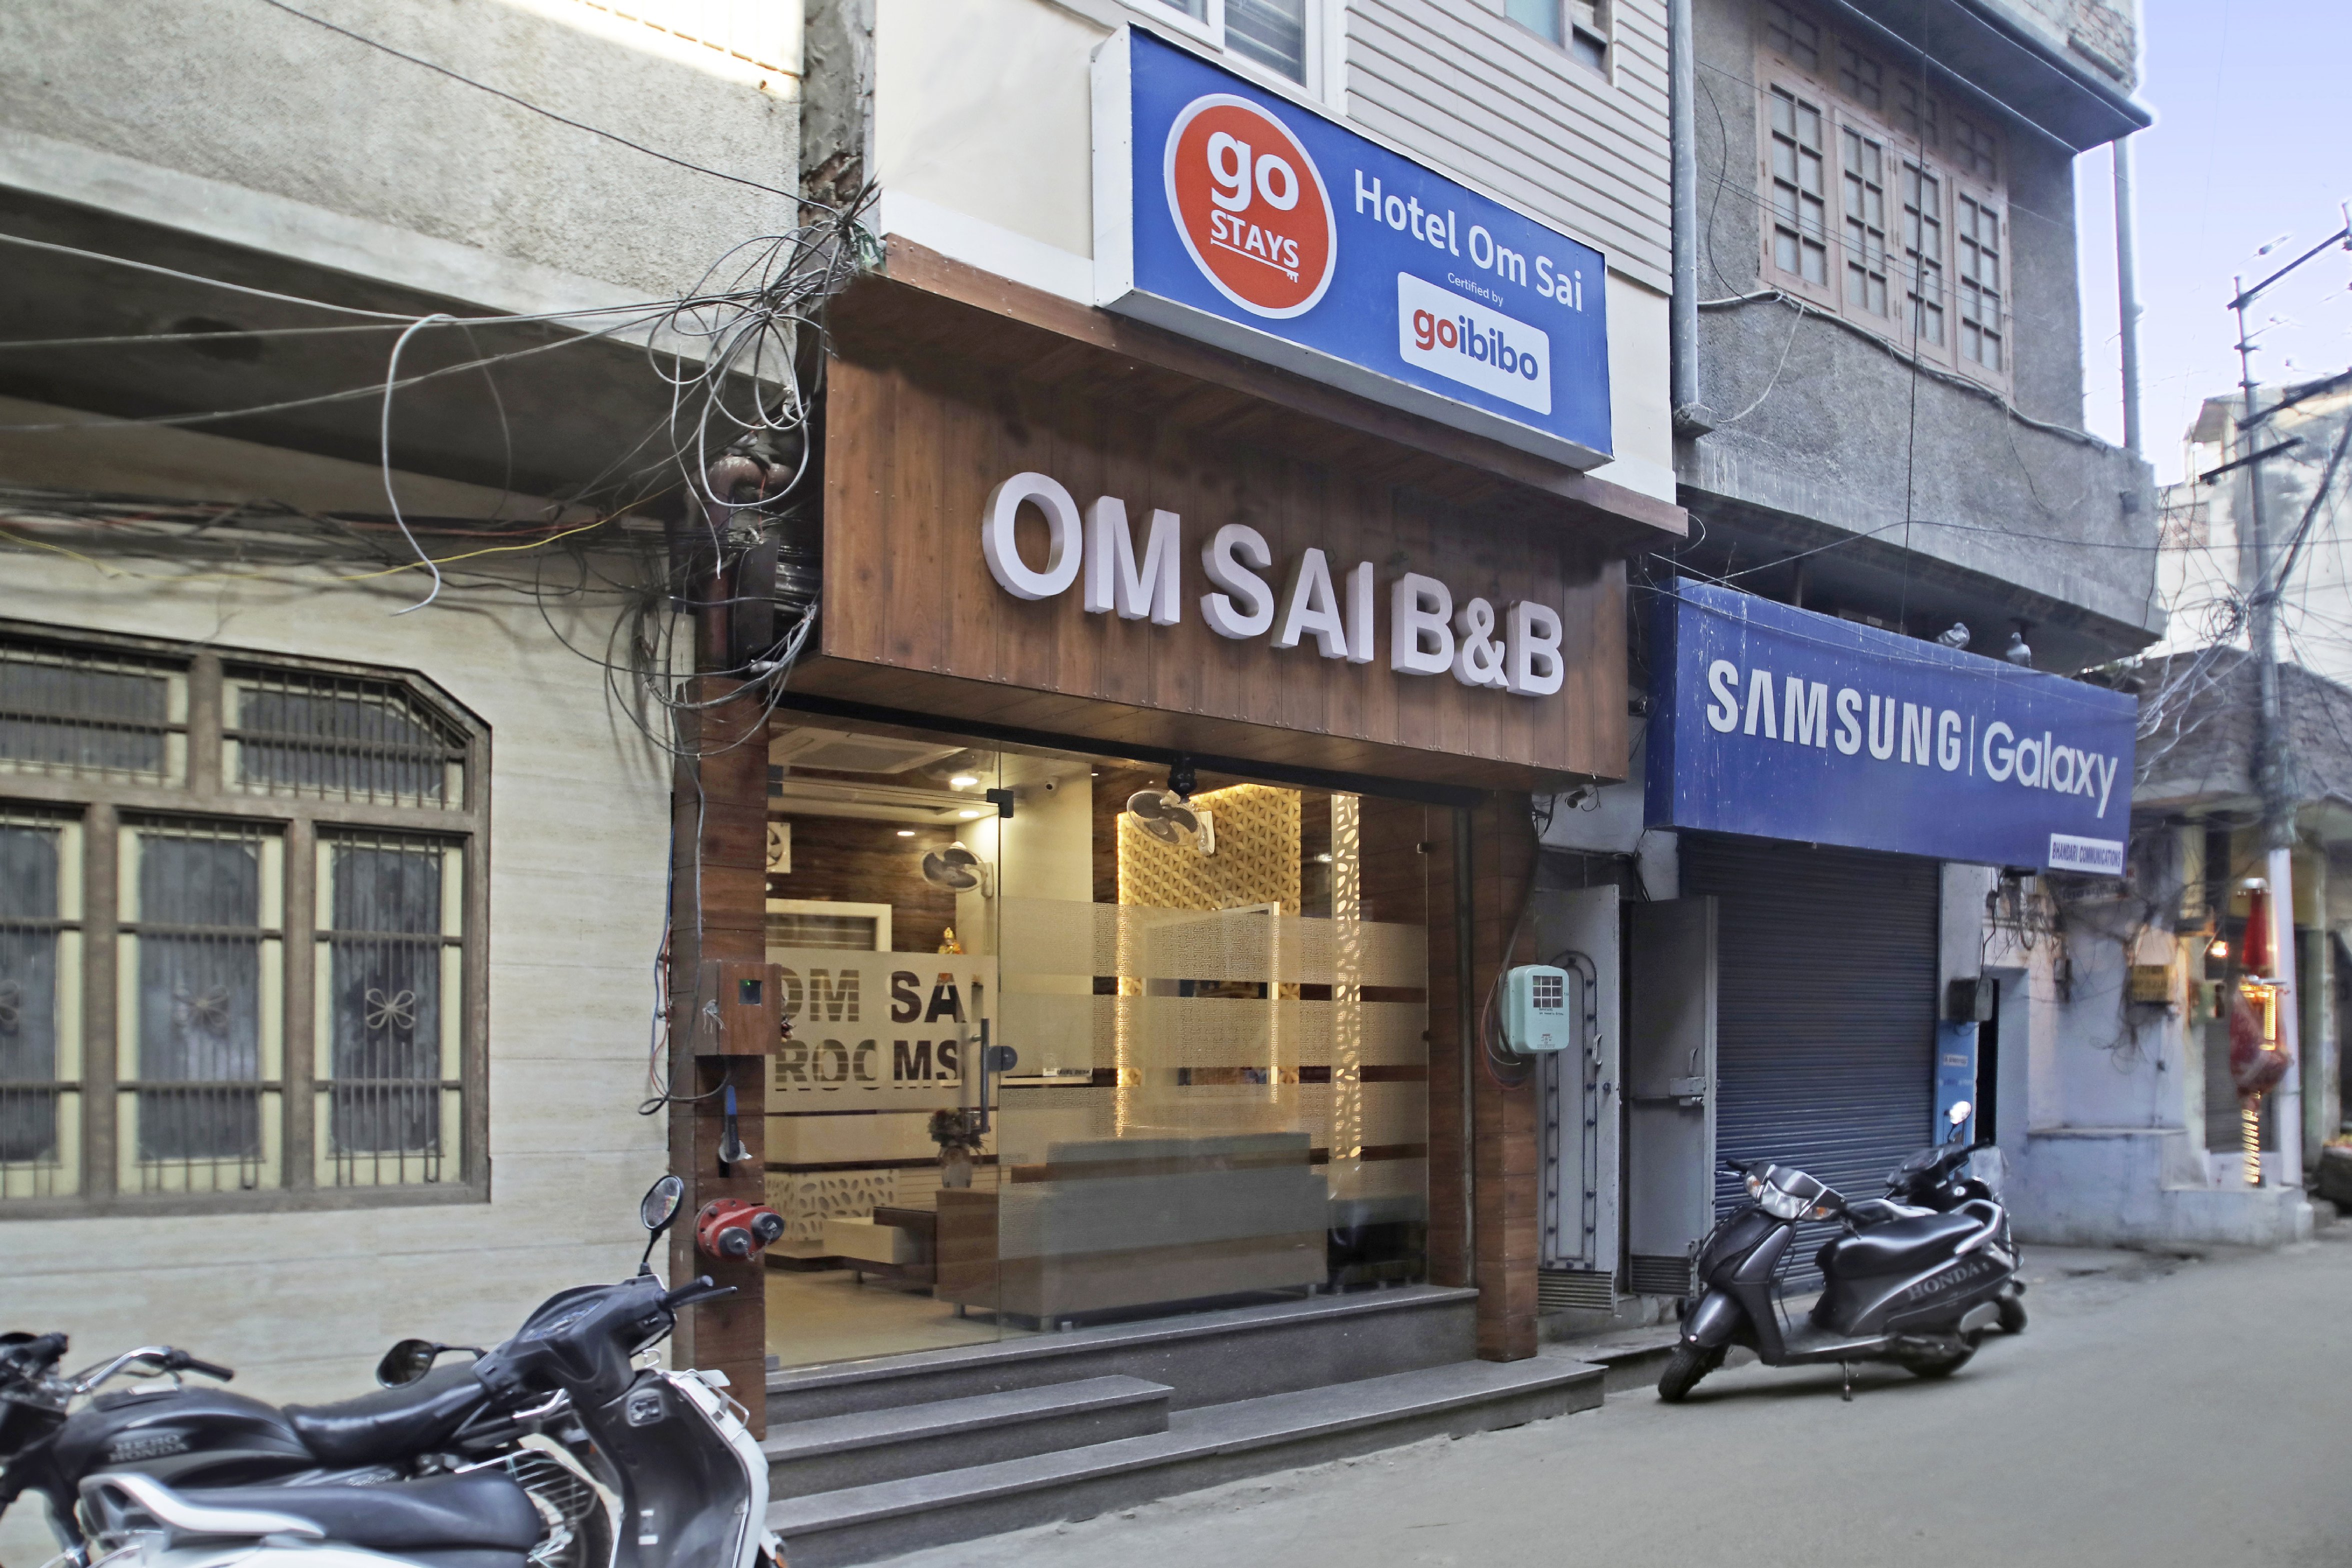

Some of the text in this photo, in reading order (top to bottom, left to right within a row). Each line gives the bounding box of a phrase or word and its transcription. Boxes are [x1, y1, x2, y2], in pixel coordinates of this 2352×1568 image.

[1207, 131, 1299, 212] go
[1211, 209, 1299, 269] STAYS
[1355, 169, 1583, 312] Hotel Om Sai
[1448, 272, 1503, 306] Certified by
[1413, 308, 1539, 381] goibibo
[982, 472, 1564, 698] OM SAI B&B
[1707, 659, 2118, 818] SAMSUNG Galaxy
[2052, 842, 2121, 867] BHANDARI COMMUNICATIONS
[886, 970, 984, 1024] SAI
[775, 1038, 966, 1092] ROOMS
[1907, 1262, 1979, 1300] HONDA
[108, 1442, 188, 1462] HONDA
